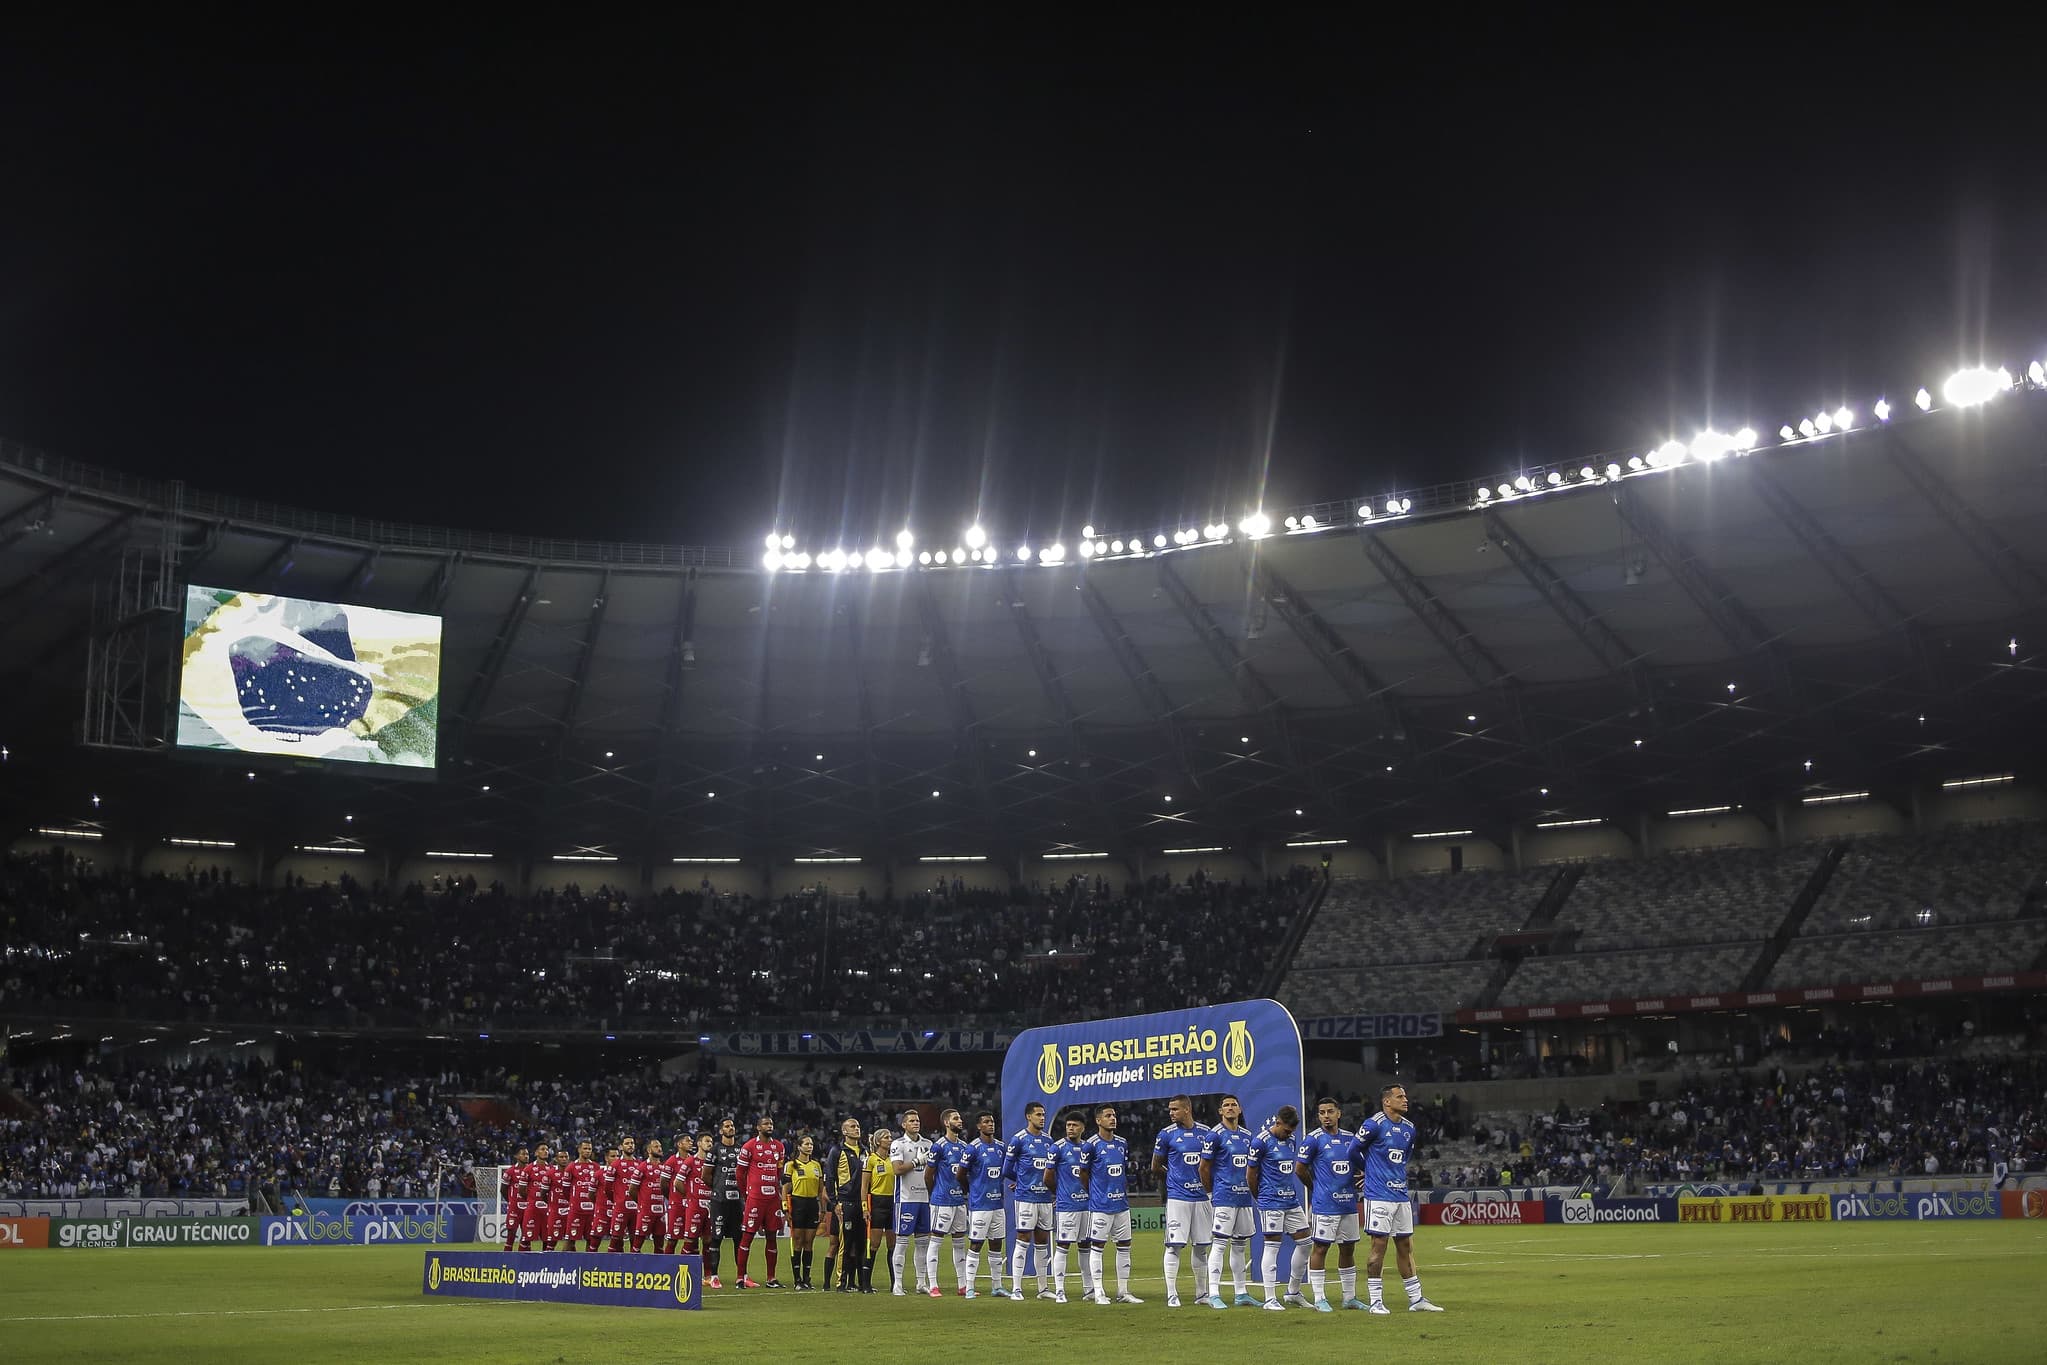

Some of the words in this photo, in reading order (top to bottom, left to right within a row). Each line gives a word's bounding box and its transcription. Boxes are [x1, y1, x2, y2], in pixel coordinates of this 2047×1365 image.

[1068, 1025, 1217, 1066] BRASILEIRÃO
[1068, 1065, 1145, 1091] sportingbet
[1152, 1059, 1200, 1080] SÉRIE
[1202, 1058, 1217, 1075] B
[1467, 1202, 1521, 1219] KRONA
[1837, 1191, 1910, 1221] pixbet
[1917, 1191, 1996, 1220] pixbet
[59, 1224, 118, 1247] grau
[76, 1239, 117, 1248] TÉCNICO
[132, 1226, 177, 1242] GRAU
[182, 1222, 250, 1241] TÉCNICO
[267, 1215, 354, 1246] pixbet
[364, 1215, 448, 1245] pixbet
[443, 1265, 516, 1285] BRASILEIRÃO
[517, 1267, 577, 1289] sportingbet
[582, 1267, 622, 1289] SÉRIE
[623, 1272, 633, 1289] B
[635, 1273, 671, 1291] 2022
